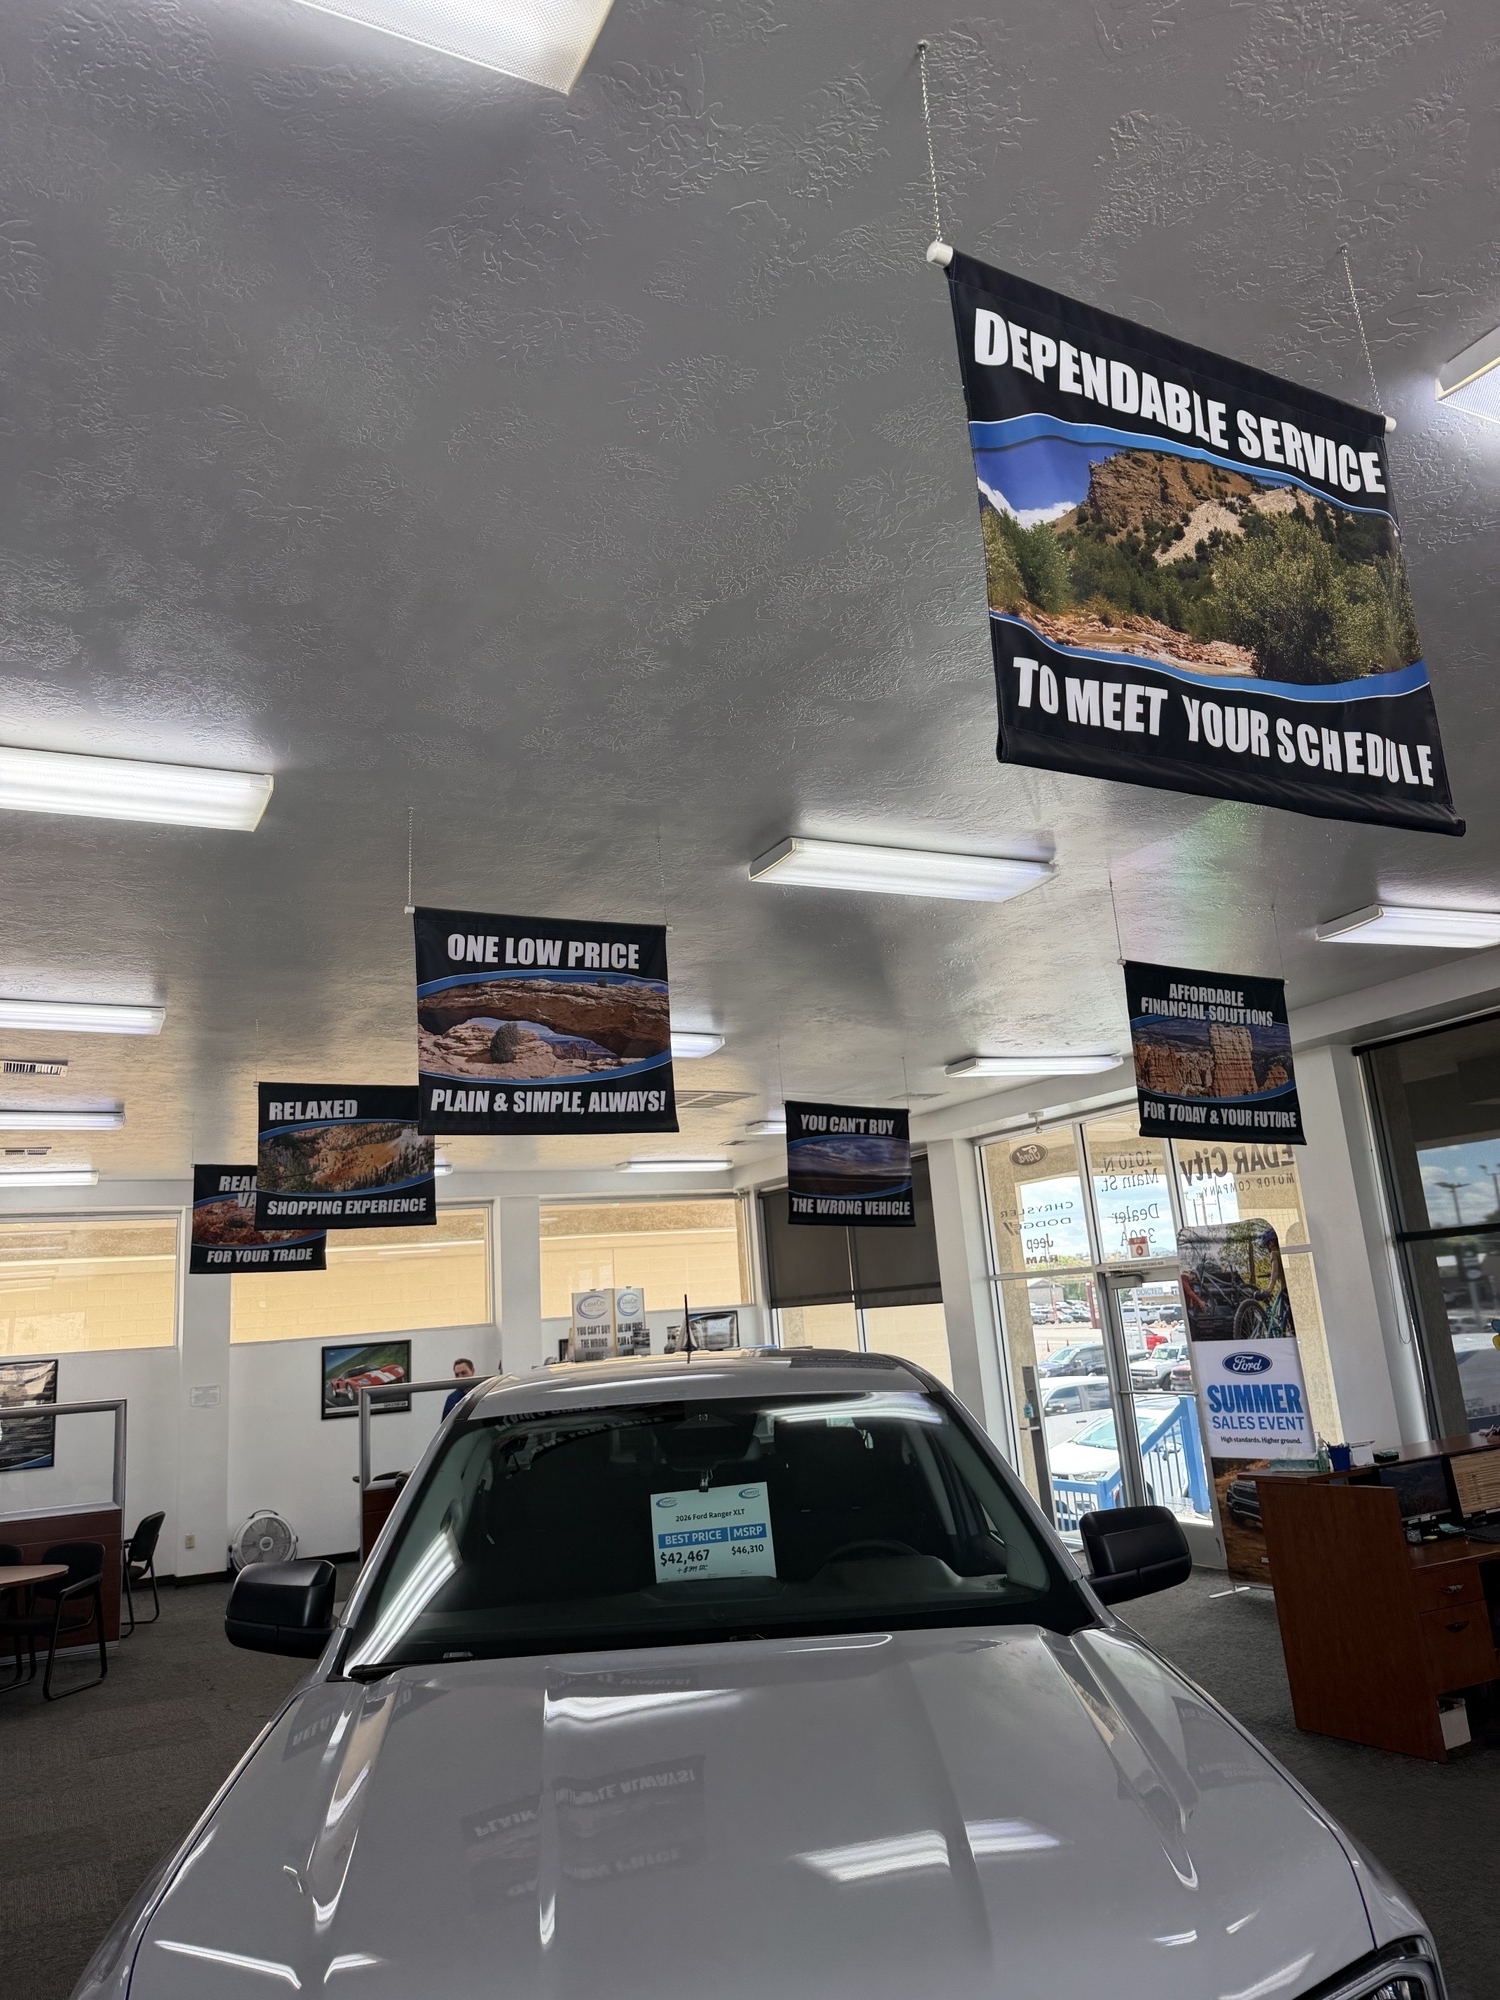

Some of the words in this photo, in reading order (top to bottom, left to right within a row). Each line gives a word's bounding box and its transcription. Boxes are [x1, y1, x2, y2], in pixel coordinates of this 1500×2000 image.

[973, 307, 1229, 450] DEPENDABLE
[1236, 408, 1387, 495] SERVICE
[1012, 656, 1060, 715] TO
[1064, 675, 1169, 736] MEET
[1181, 694, 1271, 759] YOUR
[1276, 716, 1435, 788] SCHEDULE
[447, 933, 499, 964] ONE
[505, 937, 563, 967] LOW
[567, 941, 640, 970] PRICE
[1168, 983, 1245, 1007] AFFORDABLE
[1141, 996, 1206, 1021] FINANCIAL
[1207, 1004, 1274, 1028] SOLUTIONS
[269, 1099, 359, 1121] RELAXED
[430, 1088, 490, 1113] PLAIN
[493, 1092, 509, 1112] &
[512, 1090, 585, 1115] SIMPLE,
[588, 1090, 666, 1114] ALWAYS!
[800, 1114, 828, 1131] YOU
[829, 1116, 867, 1134] CAN'T
[868, 1119, 895, 1135] BUY
[1143, 1100, 1166, 1120] FOR
[1168, 1103, 1208, 1125] TODAY
[1209, 1109, 1220, 1125] &
[1220, 1107, 1253, 1127] YOUR
[1254, 1110, 1297, 1128] FUTURE
[237, 1192, 257, 1209] VA
[267, 1199, 343, 1216] SHOPPING
[345, 1197, 427, 1215] EXPERIENCE
[791, 1197, 814, 1214] THE
[816, 1198, 863, 1216] WRONG
[864, 1201, 911, 1216] VEHICLE
[206, 1250, 232, 1264] FOR
[234, 1248, 271, 1263] YOUR
[272, 1247, 313, 1262] TRADE
[1232, 1355, 1263, 1371] Ford
[1207, 1384, 1304, 1414] SUMMER
[1212, 1415, 1257, 1430] SALES
[1259, 1416, 1305, 1431] EVENT
[1220, 1435, 1233, 1444] High
[1261, 1437, 1280, 1445] Higher
[676, 1514, 692, 1522] 2026
[692, 1513, 708, 1521] Ford
[709, 1511, 732, 1519] Ranger
[733, 1508, 746, 1516] XLT
[664, 1533, 690, 1546] BEST
[691, 1530, 722, 1542] PRICE
[733, 1525, 763, 1538] MSRP
[660, 1549, 710, 1567] $42,467
[731, 1543, 764, 1556] $46,310
